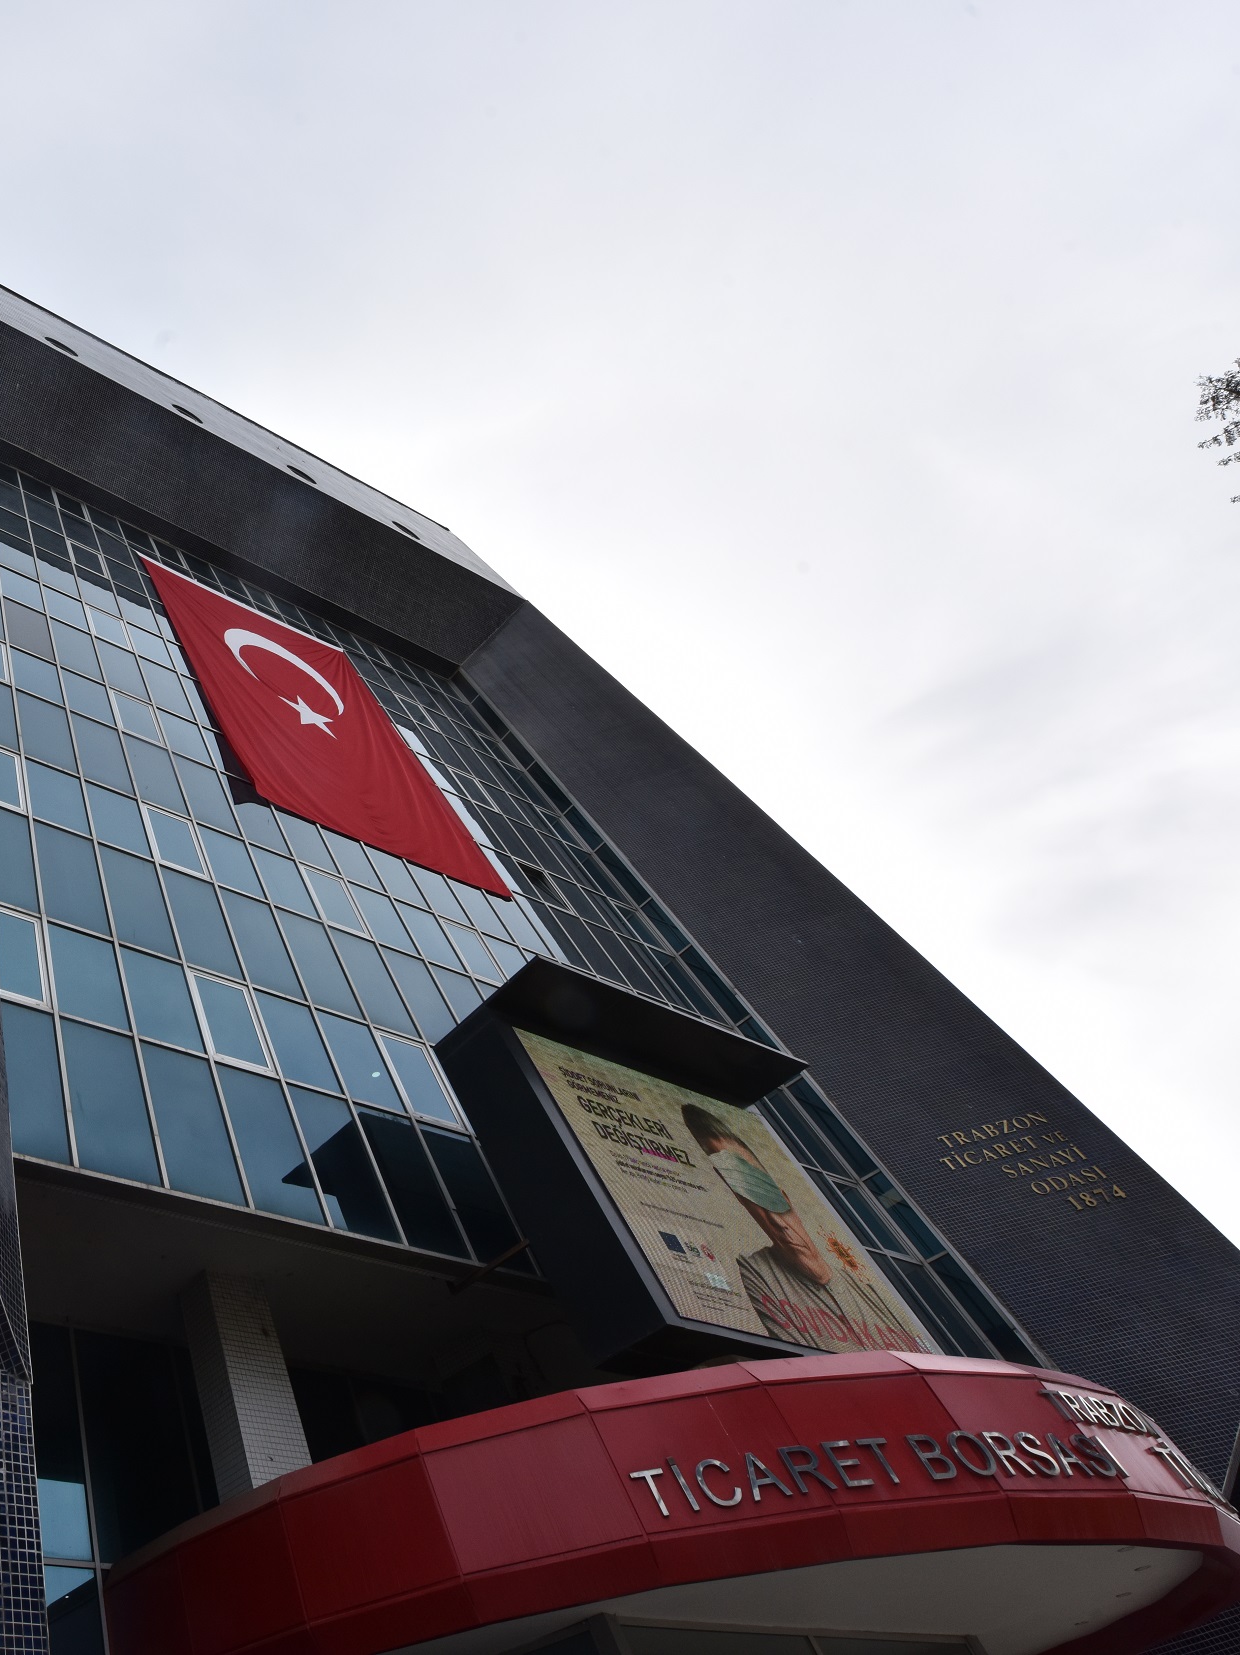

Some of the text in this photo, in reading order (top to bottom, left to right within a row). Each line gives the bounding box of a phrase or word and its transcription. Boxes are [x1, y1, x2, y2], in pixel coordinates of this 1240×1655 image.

[577, 1095, 674, 1141] GERÇEKLERİ
[936, 1111, 1049, 1149] TRABZON
[591, 1120, 697, 1168] DEĞİŞTİRMEZ
[939, 1130, 1069, 1171] TİCARET VE
[1001, 1142, 1088, 1179] SANAYİ
[1030, 1165, 1108, 1196] ODASI
[1066, 1184, 1128, 1211] 1874
[629, 1436, 901, 1517] TİCARET
[905, 1429, 1129, 1483] BORSASI
